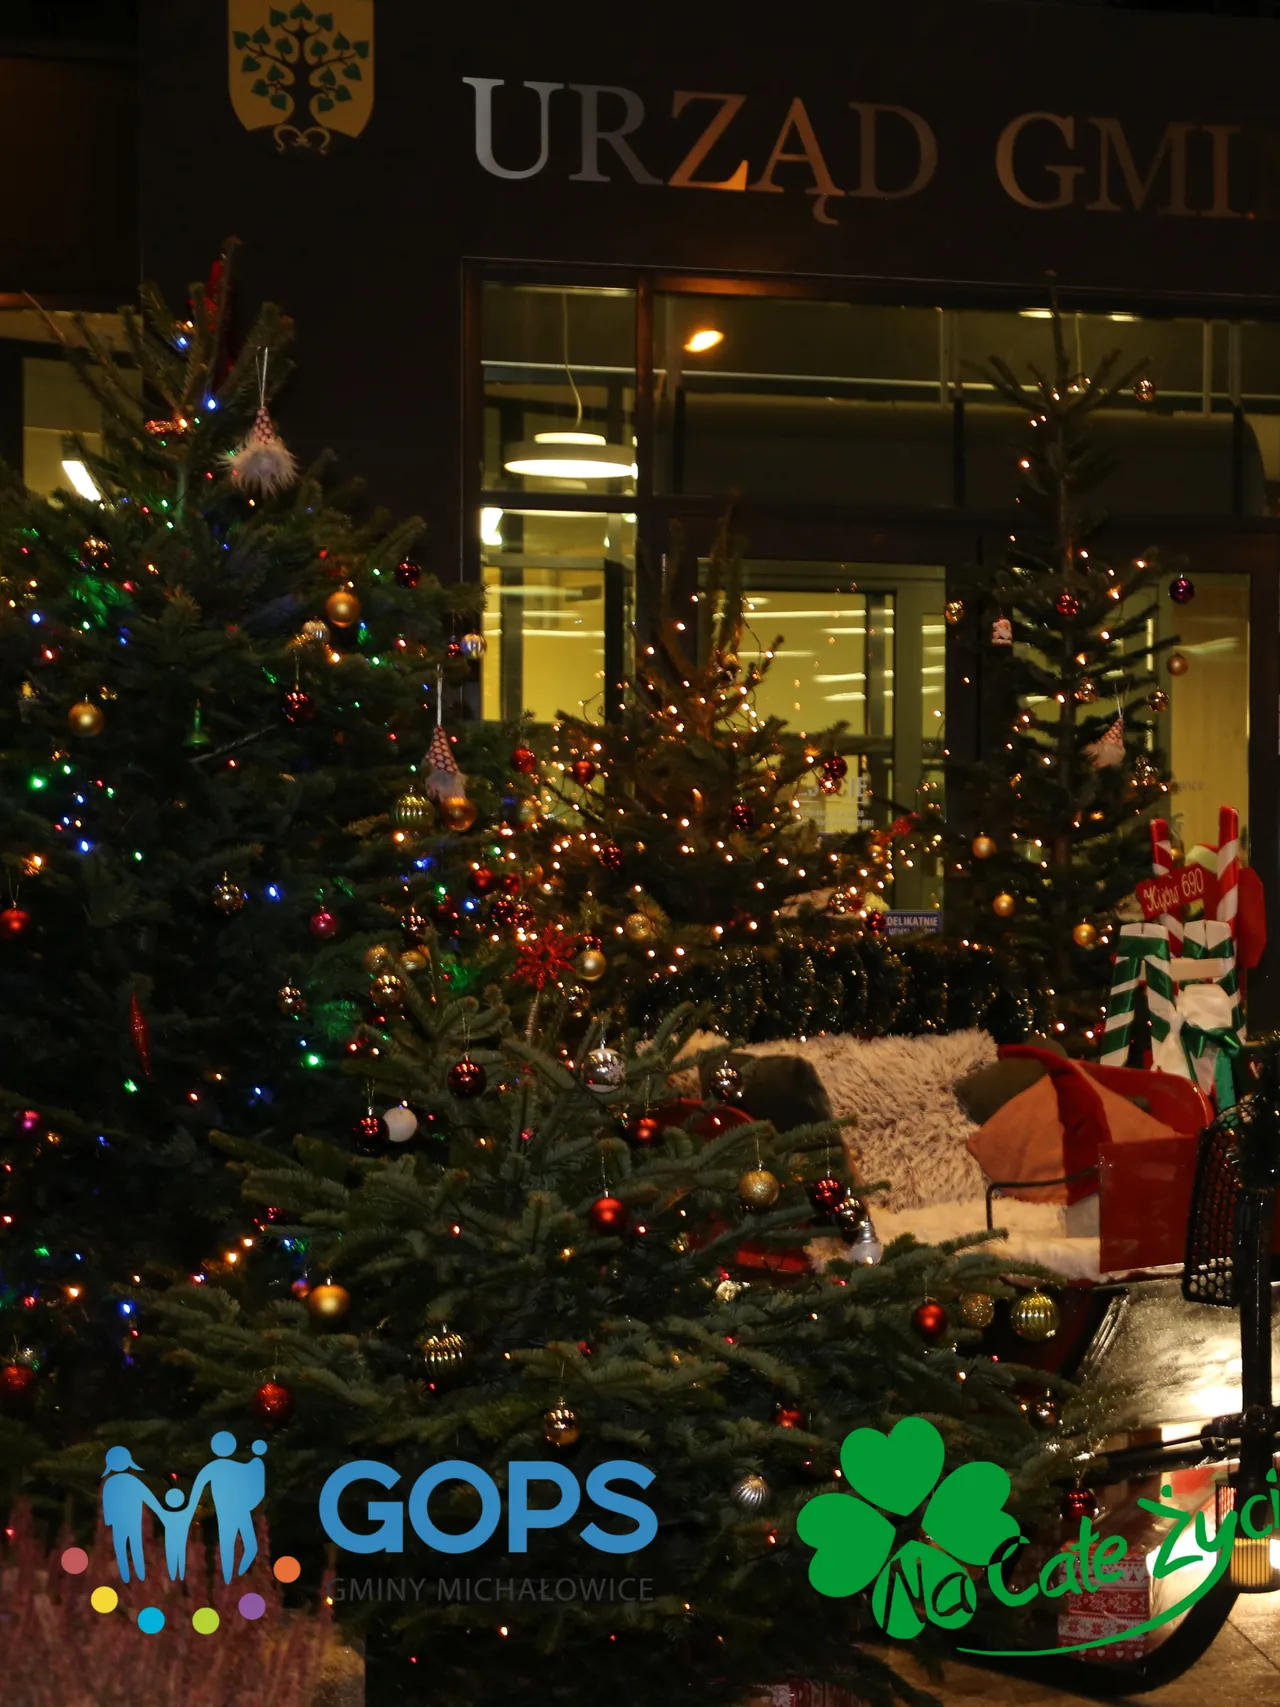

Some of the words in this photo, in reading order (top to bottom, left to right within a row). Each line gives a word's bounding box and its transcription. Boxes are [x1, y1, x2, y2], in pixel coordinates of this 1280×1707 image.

[462, 75, 938, 225] URZĄD
[1181, 867, 1204, 897] 690
[886, 916, 938, 926] DELIKATNIE
